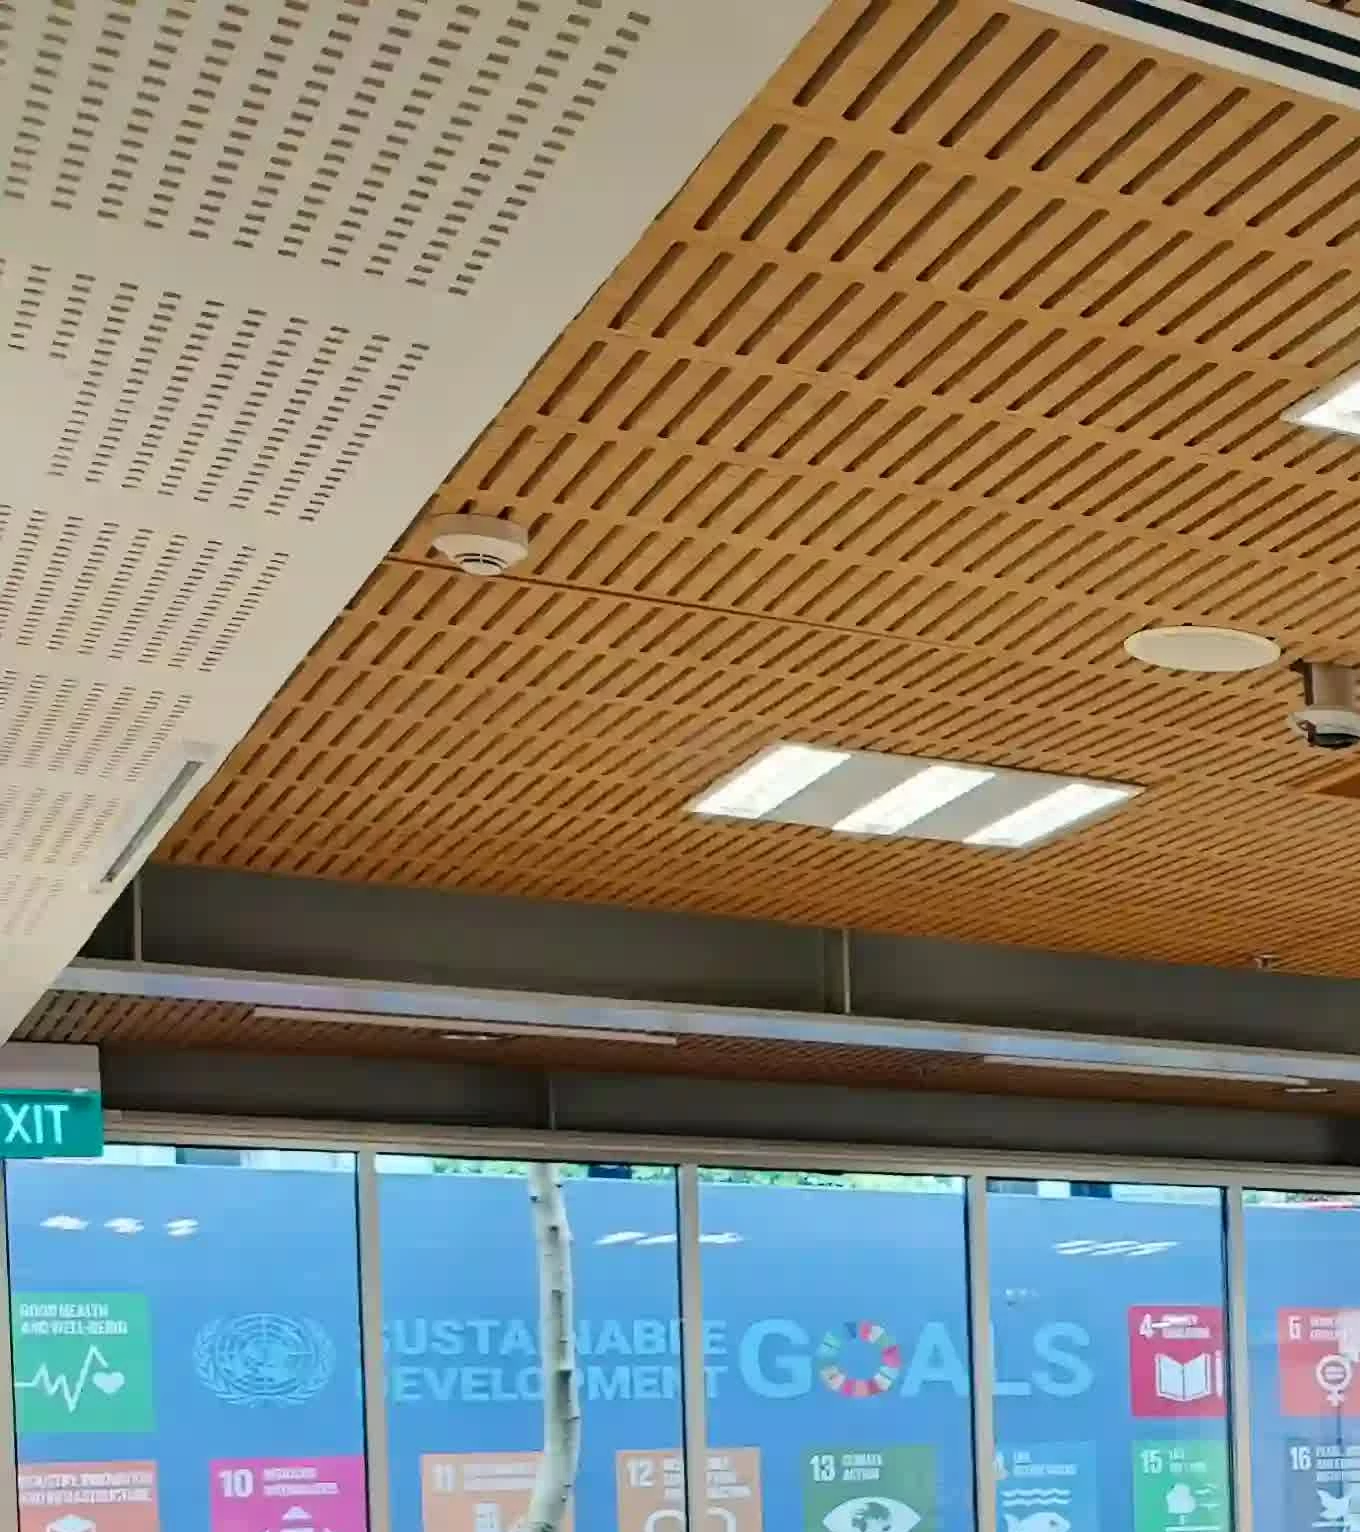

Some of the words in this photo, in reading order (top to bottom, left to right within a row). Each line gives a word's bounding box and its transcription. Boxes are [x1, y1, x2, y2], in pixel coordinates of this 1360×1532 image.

[0, 1104, 69, 1144] XIT
[808, 1455, 836, 1482] 13
[1141, 1449, 1163, 1474] 15
[1290, 1446, 1312, 1470] 16
[219, 1469, 253, 1497] 10
[626, 1457, 655, 1487] 12
